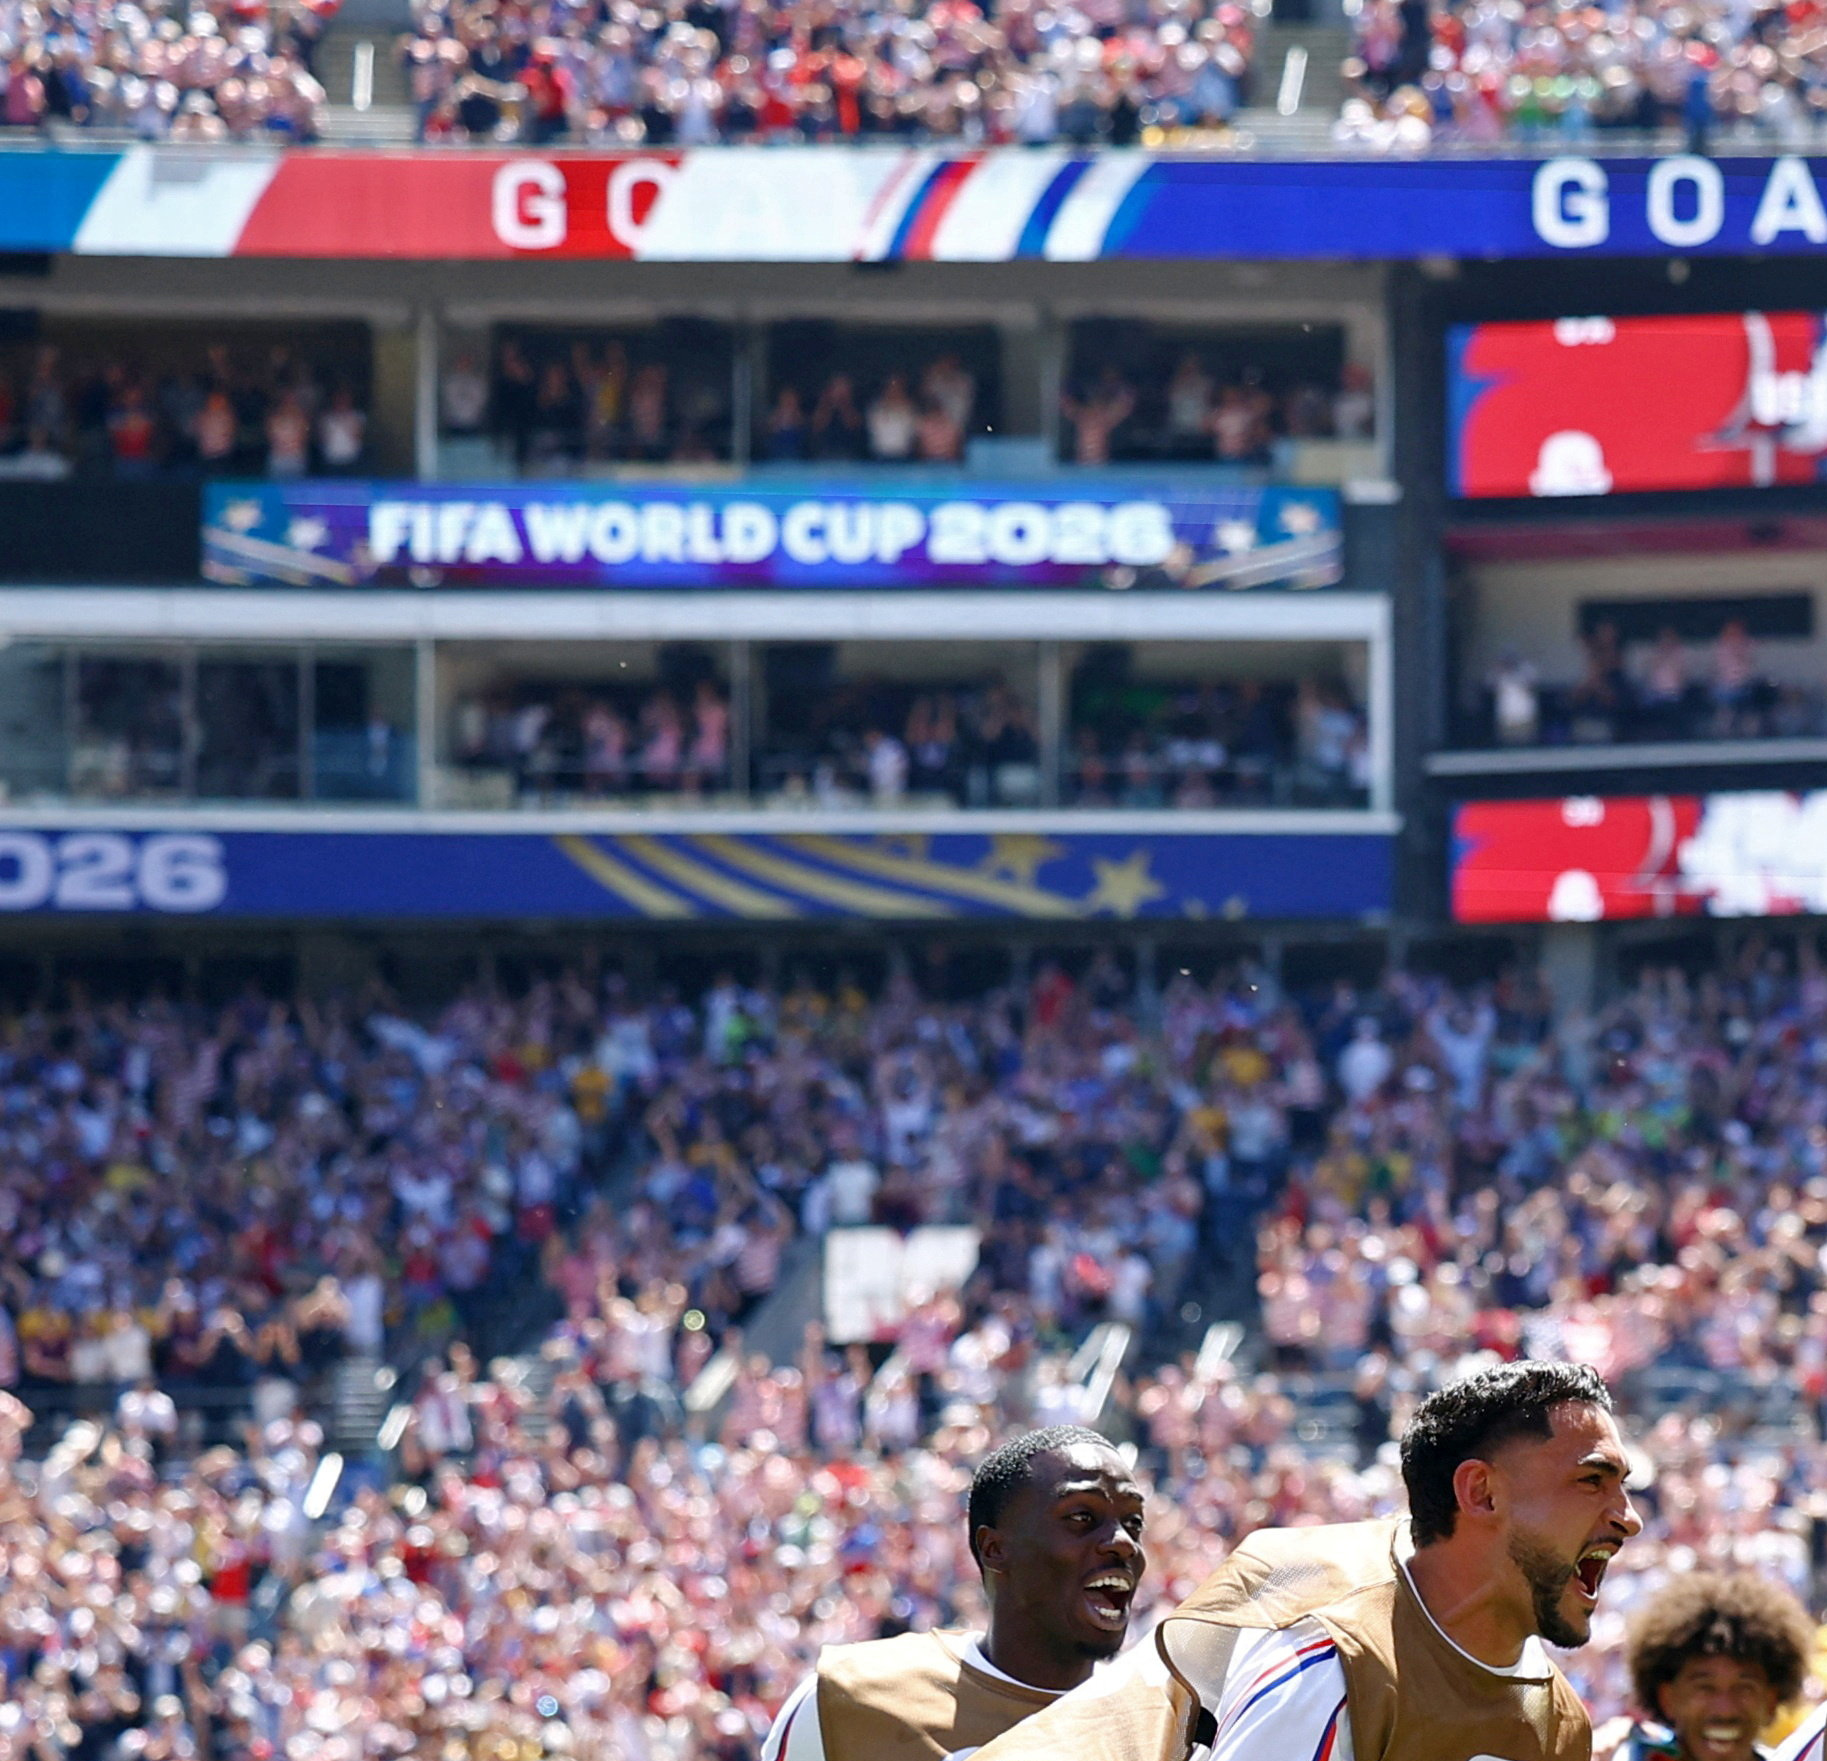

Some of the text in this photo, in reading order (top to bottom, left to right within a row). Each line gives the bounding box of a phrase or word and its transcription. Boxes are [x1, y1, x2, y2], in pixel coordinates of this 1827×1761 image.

[371, 501, 1172, 567] FIFA WORLD CUP 2026
